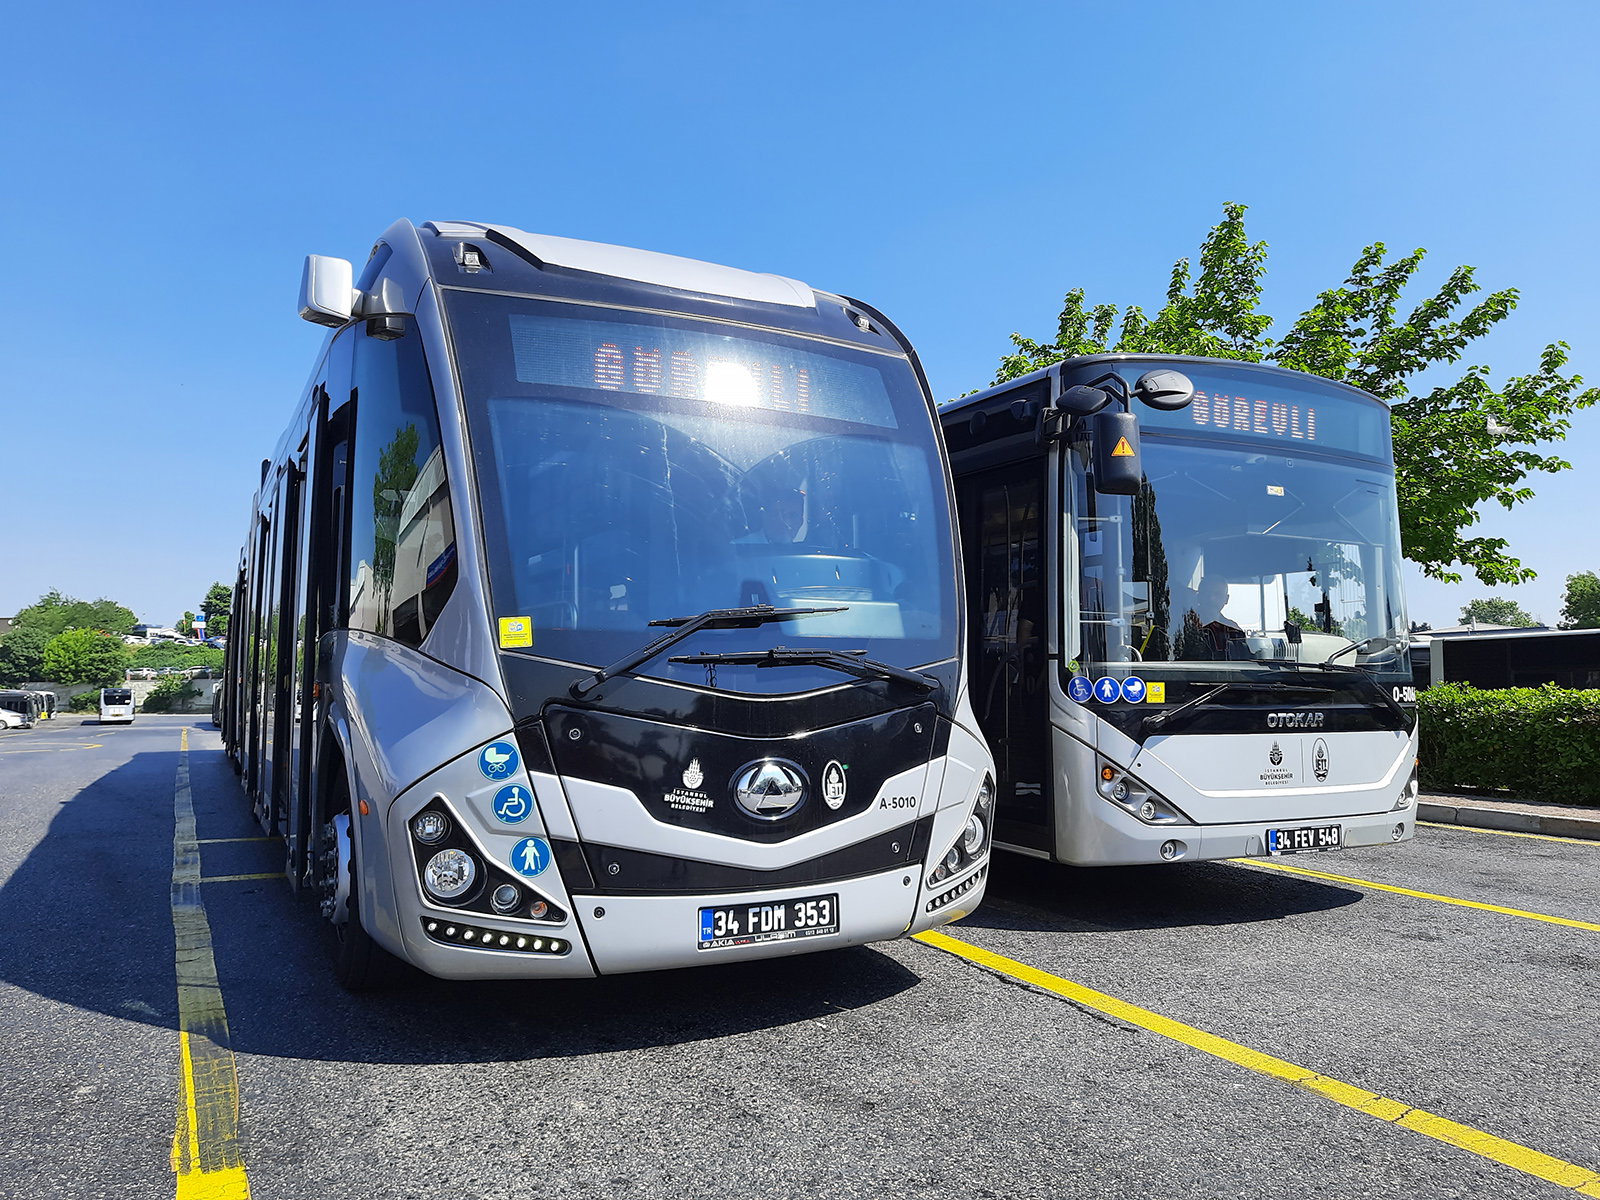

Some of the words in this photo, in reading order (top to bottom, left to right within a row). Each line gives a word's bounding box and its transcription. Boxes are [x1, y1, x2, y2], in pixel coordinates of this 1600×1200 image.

[1267, 712, 1324, 728] OTOKAR
[879, 796, 917, 809] A-5010
[1276, 831, 1291, 849] 34
[1294, 829, 1315, 848] FEV
[1319, 827, 1338, 846] 548
[714, 910, 740, 937] 34
[748, 904, 786, 933] FDM
[794, 900, 830, 928] 353
[702, 927, 712, 935] TR
[710, 939, 735, 948] AKIA
